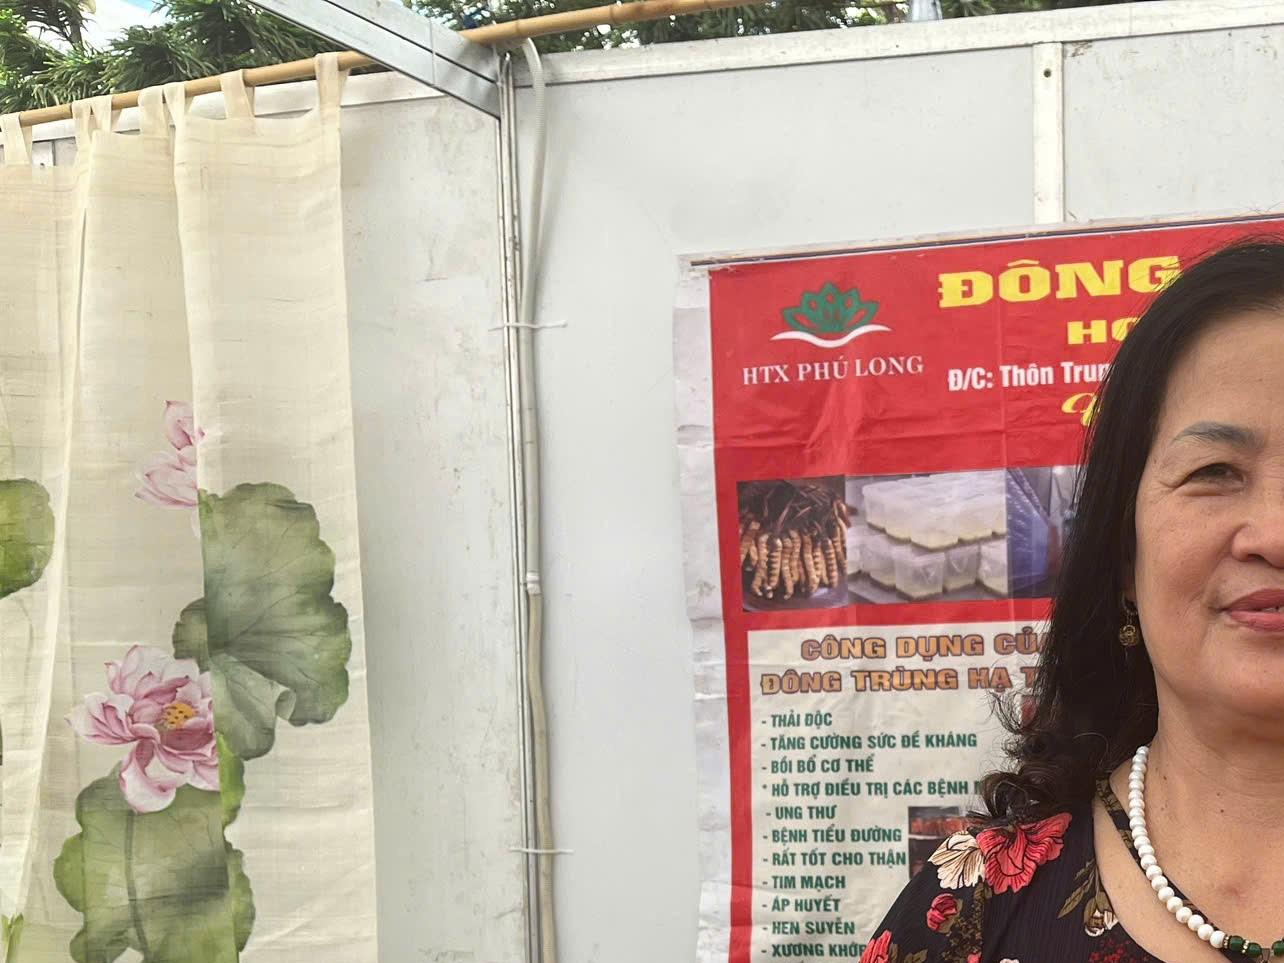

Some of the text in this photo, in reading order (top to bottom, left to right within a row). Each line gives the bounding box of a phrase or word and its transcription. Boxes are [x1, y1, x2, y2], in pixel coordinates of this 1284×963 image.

[937, 255, 1179, 308] ĐÔNG
[742, 356, 924, 385] HTX PHÚ LONG
[948, 363, 1052, 391] Đ/C: Thôn
[801, 634, 984, 662] CÔNG DỤNG
[760, 670, 841, 695] ĐÔNG
[850, 666, 958, 691] TRÙNG
[968, 666, 1013, 693] HẠ
[771, 711, 832, 728] THẢI ĐỘC
[770, 735, 805, 750] TĂNG
[810, 735, 862, 750] CƯỜNG
[868, 732, 898, 749] SỨC
[925, 732, 977, 747] KHÁNG
[821, 757, 841, 772] CƠ
[793, 783, 820, 798] TRỢ
[866, 782, 888, 798] TRỊ
[893, 780, 924, 796] CÁC
[928, 780, 969, 797] BỆNH
[775, 805, 837, 820] UNG THƯ
[773, 829, 808, 845] BỆNH
[850, 827, 901, 843] ĐƯỜNG
[773, 849, 906, 867] RẤT TỐT CHO THẬN
[772, 876, 846, 891] TIM MẠCH
[772, 896, 840, 913] ÁP HUYẾT
[772, 921, 800, 935] HEN
[771, 942, 824, 957] XƯƠNG
